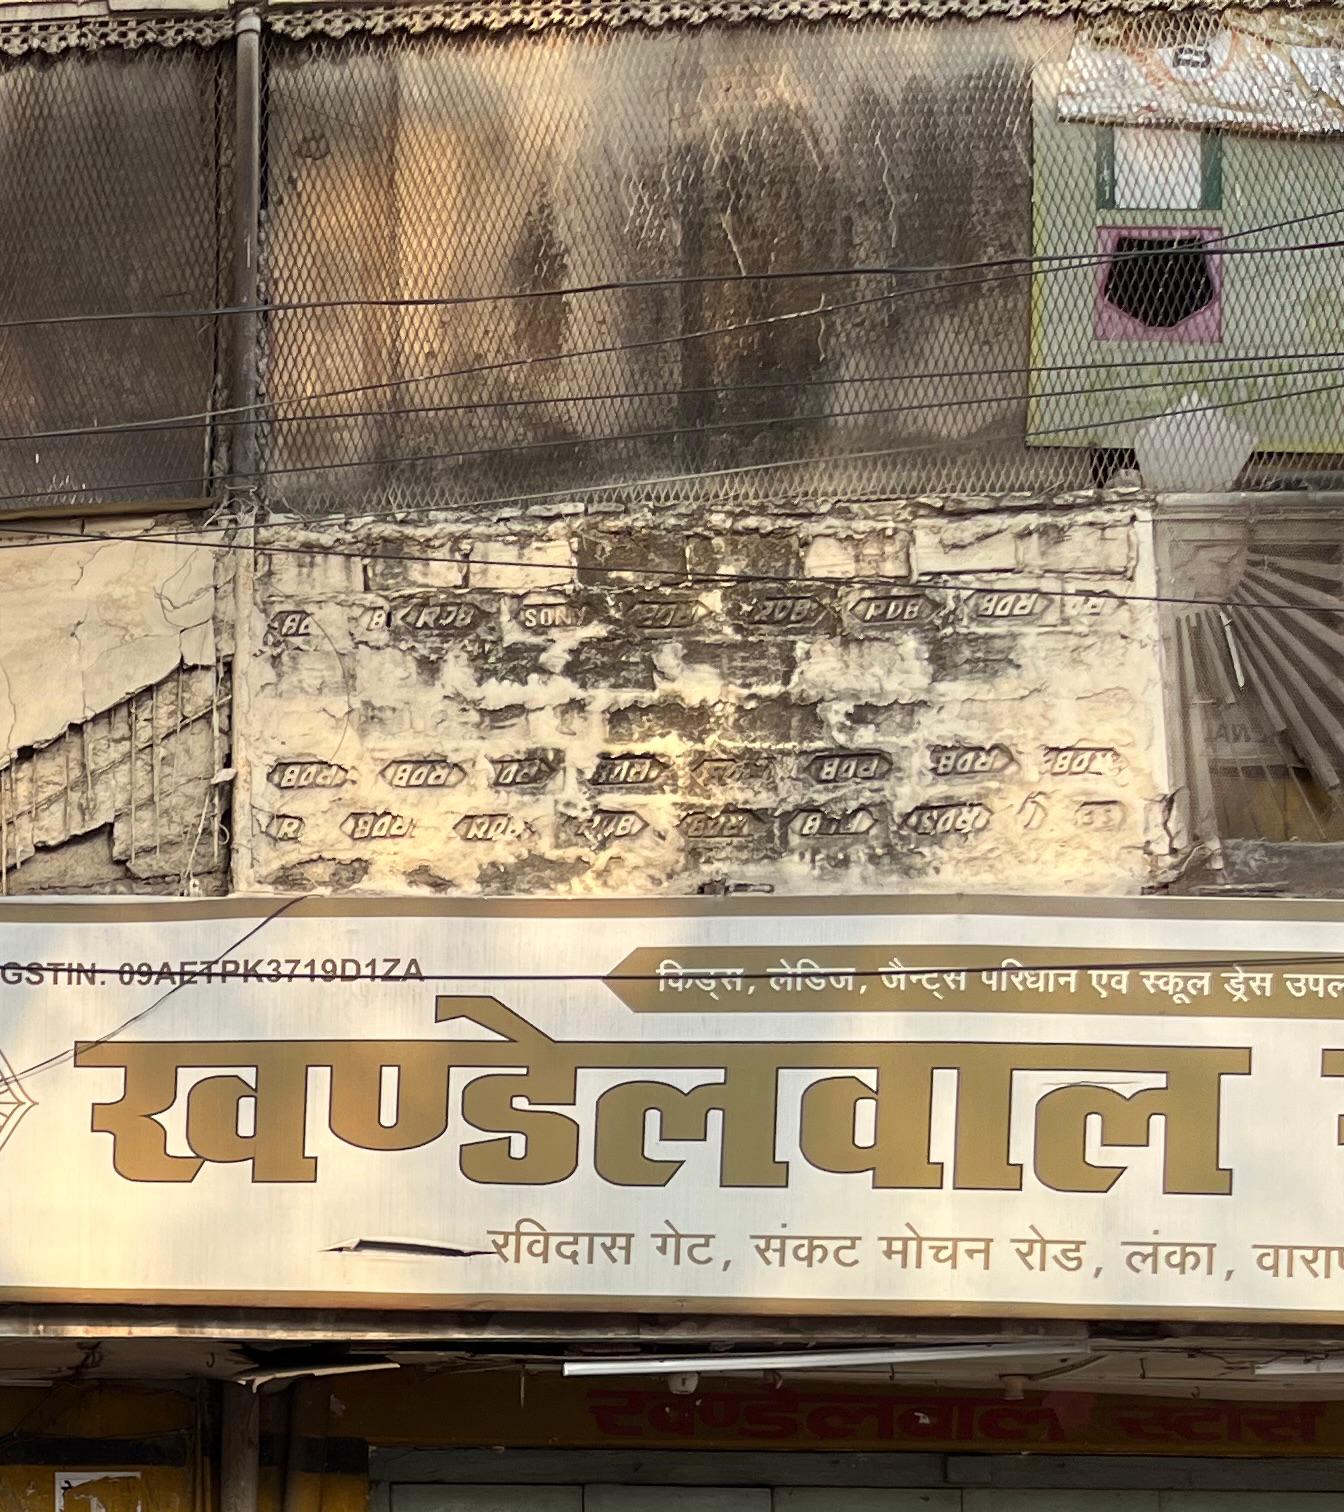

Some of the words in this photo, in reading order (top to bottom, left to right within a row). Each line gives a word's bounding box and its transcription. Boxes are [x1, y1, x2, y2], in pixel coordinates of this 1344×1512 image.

[0, 961, 107, 986] GSTIN:
[117, 957, 426, 986] 09AETPK3719D1ZA
[980, 958, 1078, 993] परिधान
[1139, 970, 1211, 1004] स्कूल
[1220, 963, 1273, 1002] ड्रेस
[74, 995, 1252, 1196] खण्डेलवाल
[487, 1217, 634, 1265] रविदास
[651, 1219, 732, 1272] गेट,
[750, 1223, 862, 1268] संकट
[878, 1222, 994, 1271] मोचन
[1010, 1224, 1103, 1279] रोड,
[1121, 1229, 1235, 1281] लंका,
